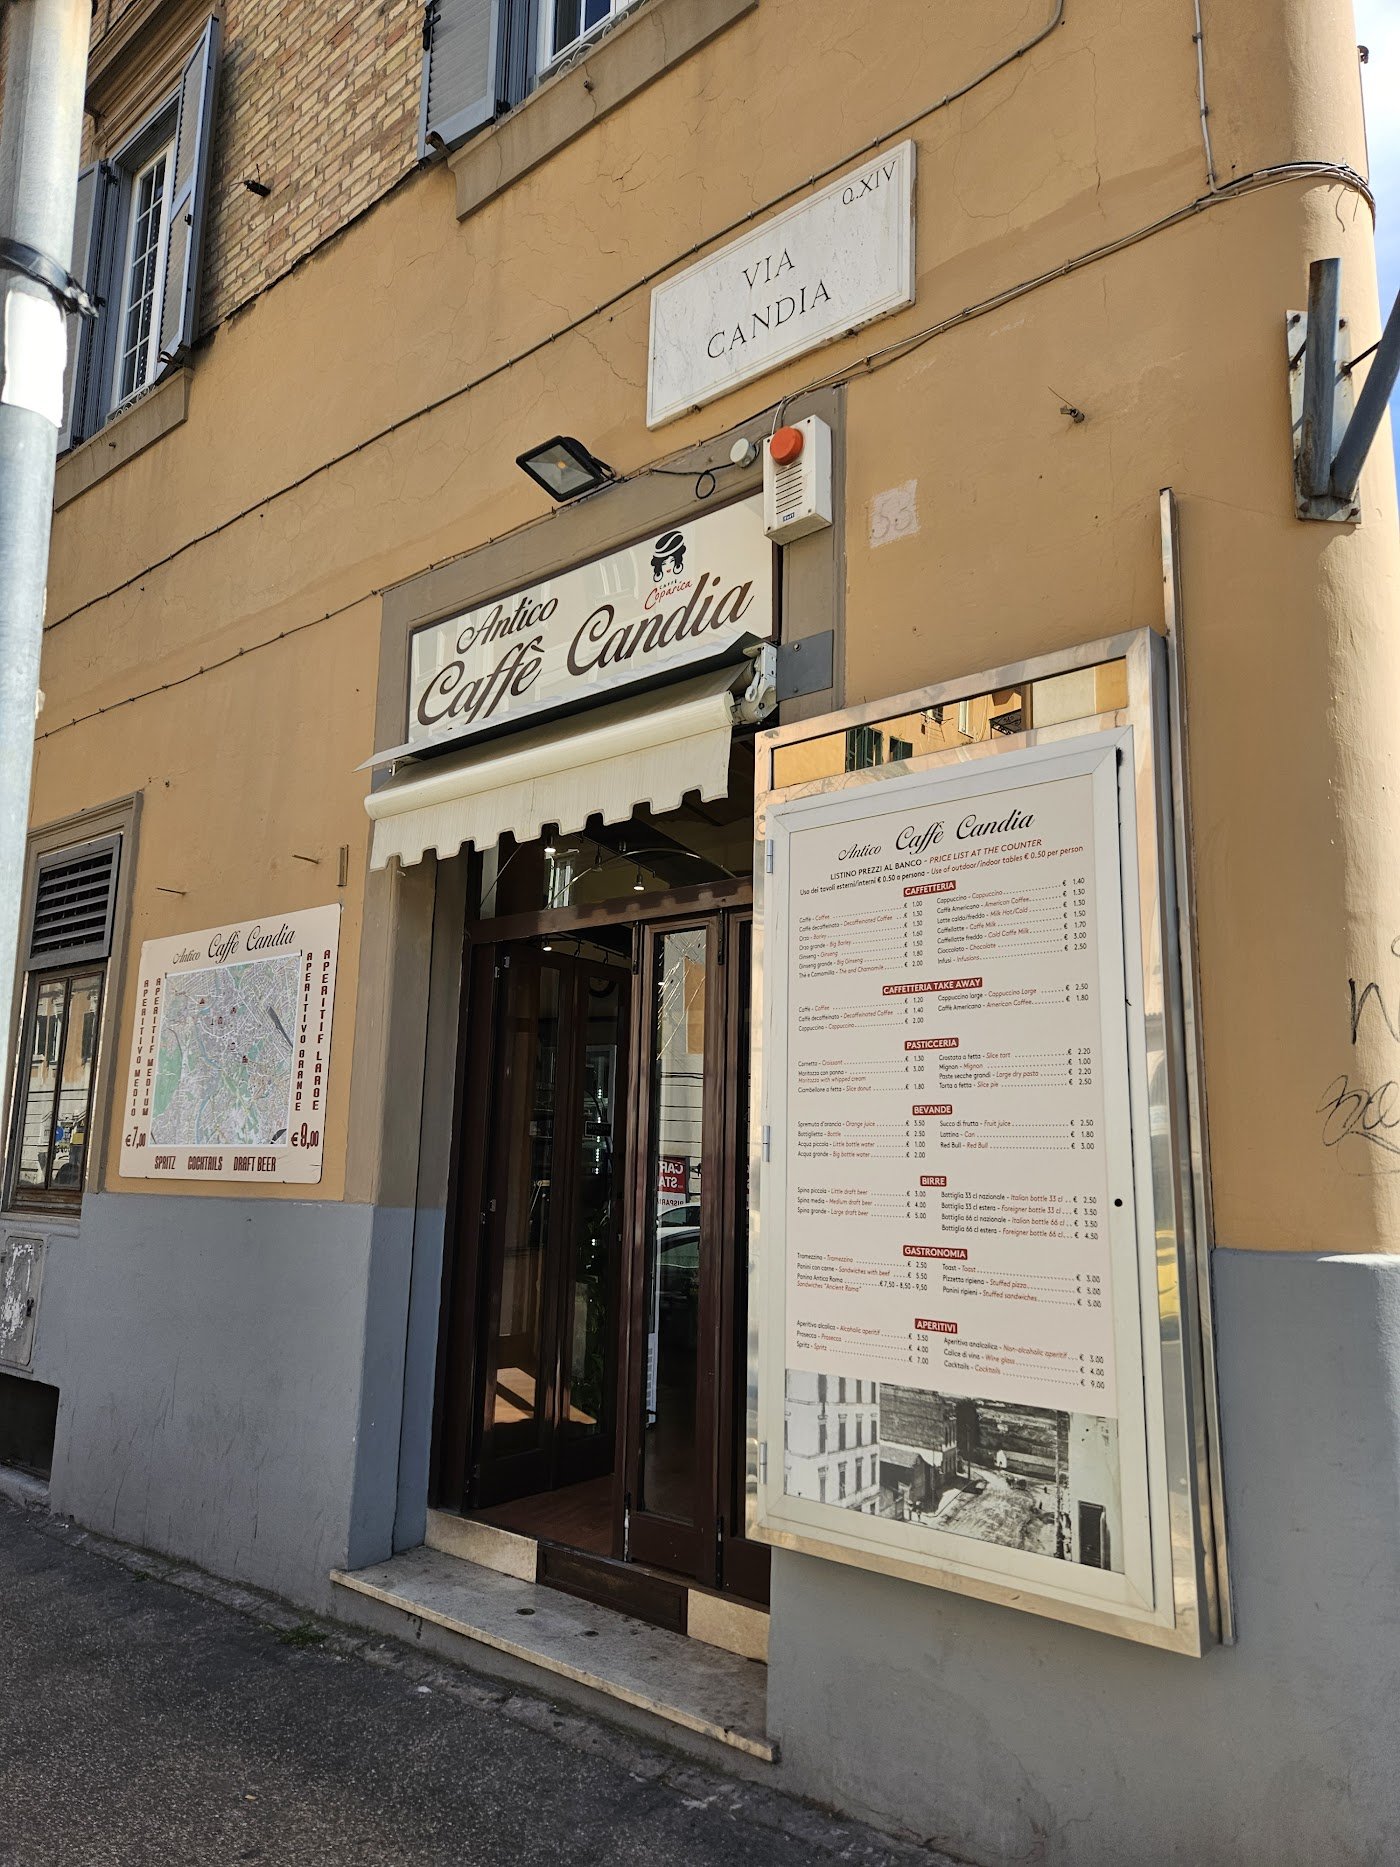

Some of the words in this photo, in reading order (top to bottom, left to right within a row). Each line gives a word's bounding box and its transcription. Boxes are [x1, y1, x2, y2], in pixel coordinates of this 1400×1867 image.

[742, 248, 795, 290] VIA
[707, 279, 832, 359] CANDIA
[456, 597, 558, 655] Antico
[417, 635, 545, 727] Caffè
[566, 572, 755, 677] Candia
[838, 843, 882, 861] Antico
[895, 820, 945, 855] Caffè
[956, 809, 1034, 840] Candia
[810, 886, 819, 894] dei
[819, 883, 836, 893] tavoli
[882, 874, 896, 883] 0.50
[901, 871, 925, 881] persona
[931, 867, 944, 875] Use
[942, 864, 951, 873] of
[1002, 854, 1023, 864] tables
[1030, 849, 1046, 859] 0.50
[1046, 849, 1059, 859] per
[1059, 846, 1084, 857] person
[830, 869, 857, 881] LISTINO
[858, 865, 882, 876] PREZZI
[883, 863, 893, 871] AL
[894, 858, 922, 870] BANCO
[929, 853, 951, 864] PRICE
[949, 850, 970, 860] LIST
[970, 848, 982, 857] AT
[983, 845, 999, 855] THE
[1000, 838, 1042, 852] COUNTER
[904, 881, 955, 896] CAFFETTERIA
[172, 947, 201, 965] Antico
[208, 930, 241, 964] Caffè
[246, 923, 296, 951] Candia
[300, 952, 313, 1044] APERITIVO
[317, 949, 331, 1044] APERITIF
[882, 982, 933, 995] CAFFETTERIA
[932, 980, 955, 991] TAKE
[954, 977, 981, 989] AWAY
[136, 979, 149, 1064] APERITIVO
[149, 977, 161, 1054] APERITIF
[906, 1038, 958, 1050] PASTICCERIA
[130, 1069, 141, 1117] MEDIO
[142, 1058, 154, 1116] MEDIUM
[913, 1104, 953, 1115] BEVANDE
[154, 1155, 176, 1170] SPRITZ
[187, 1156, 223, 1171] COCKTAILS
[233, 1156, 256, 1172] DRAFT
[257, 1156, 277, 1172] BEER
[921, 1176, 946, 1186] BIRRE
[904, 1245, 967, 1259] GASTRONOMIA
[915, 1319, 957, 1333] APERITIVI
